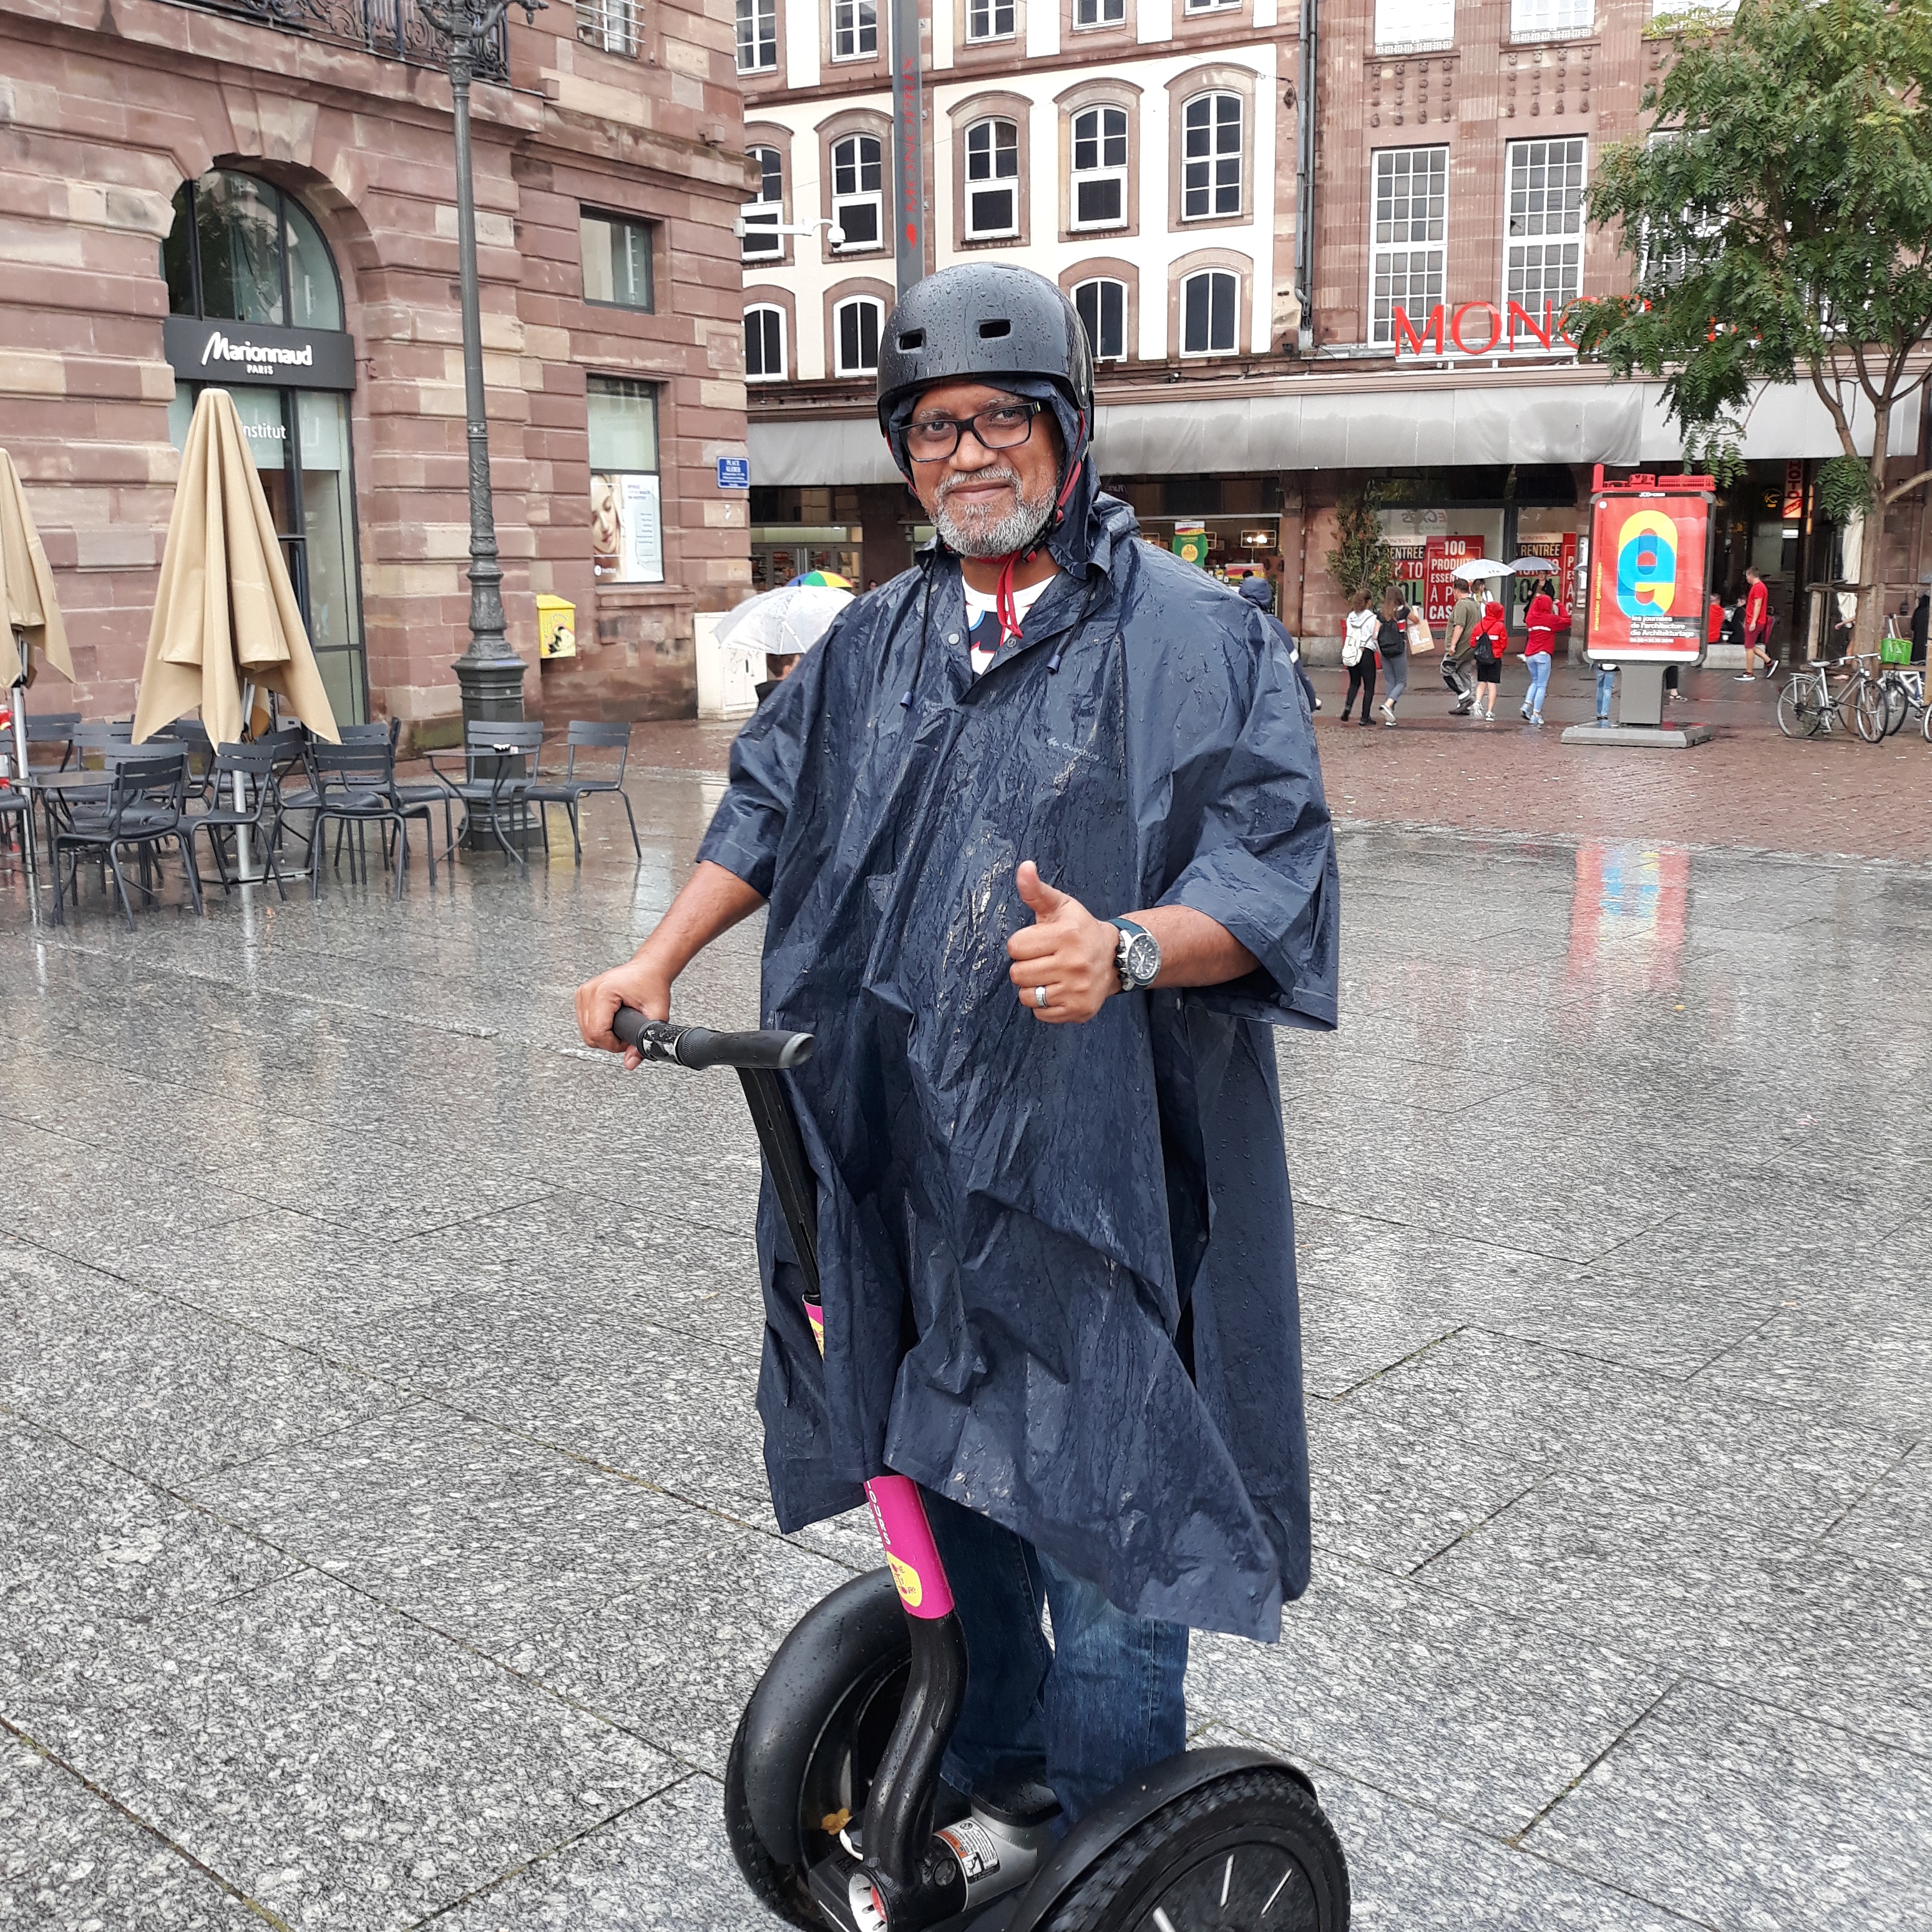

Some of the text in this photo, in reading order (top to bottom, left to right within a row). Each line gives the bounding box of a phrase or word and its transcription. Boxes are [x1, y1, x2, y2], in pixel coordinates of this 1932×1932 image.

[902, 54, 917, 213] MONOPRIX
[201, 331, 313, 366] Marionnaud
[246, 364, 273, 374] PARIS
[1387, 546, 1424, 559] ENTRÉE
[1444, 540, 1466, 556] 100
[1407, 562, 1423, 578] TO
[1430, 573, 1459, 583] ESSEN
[1429, 605, 1454, 620] CAS
